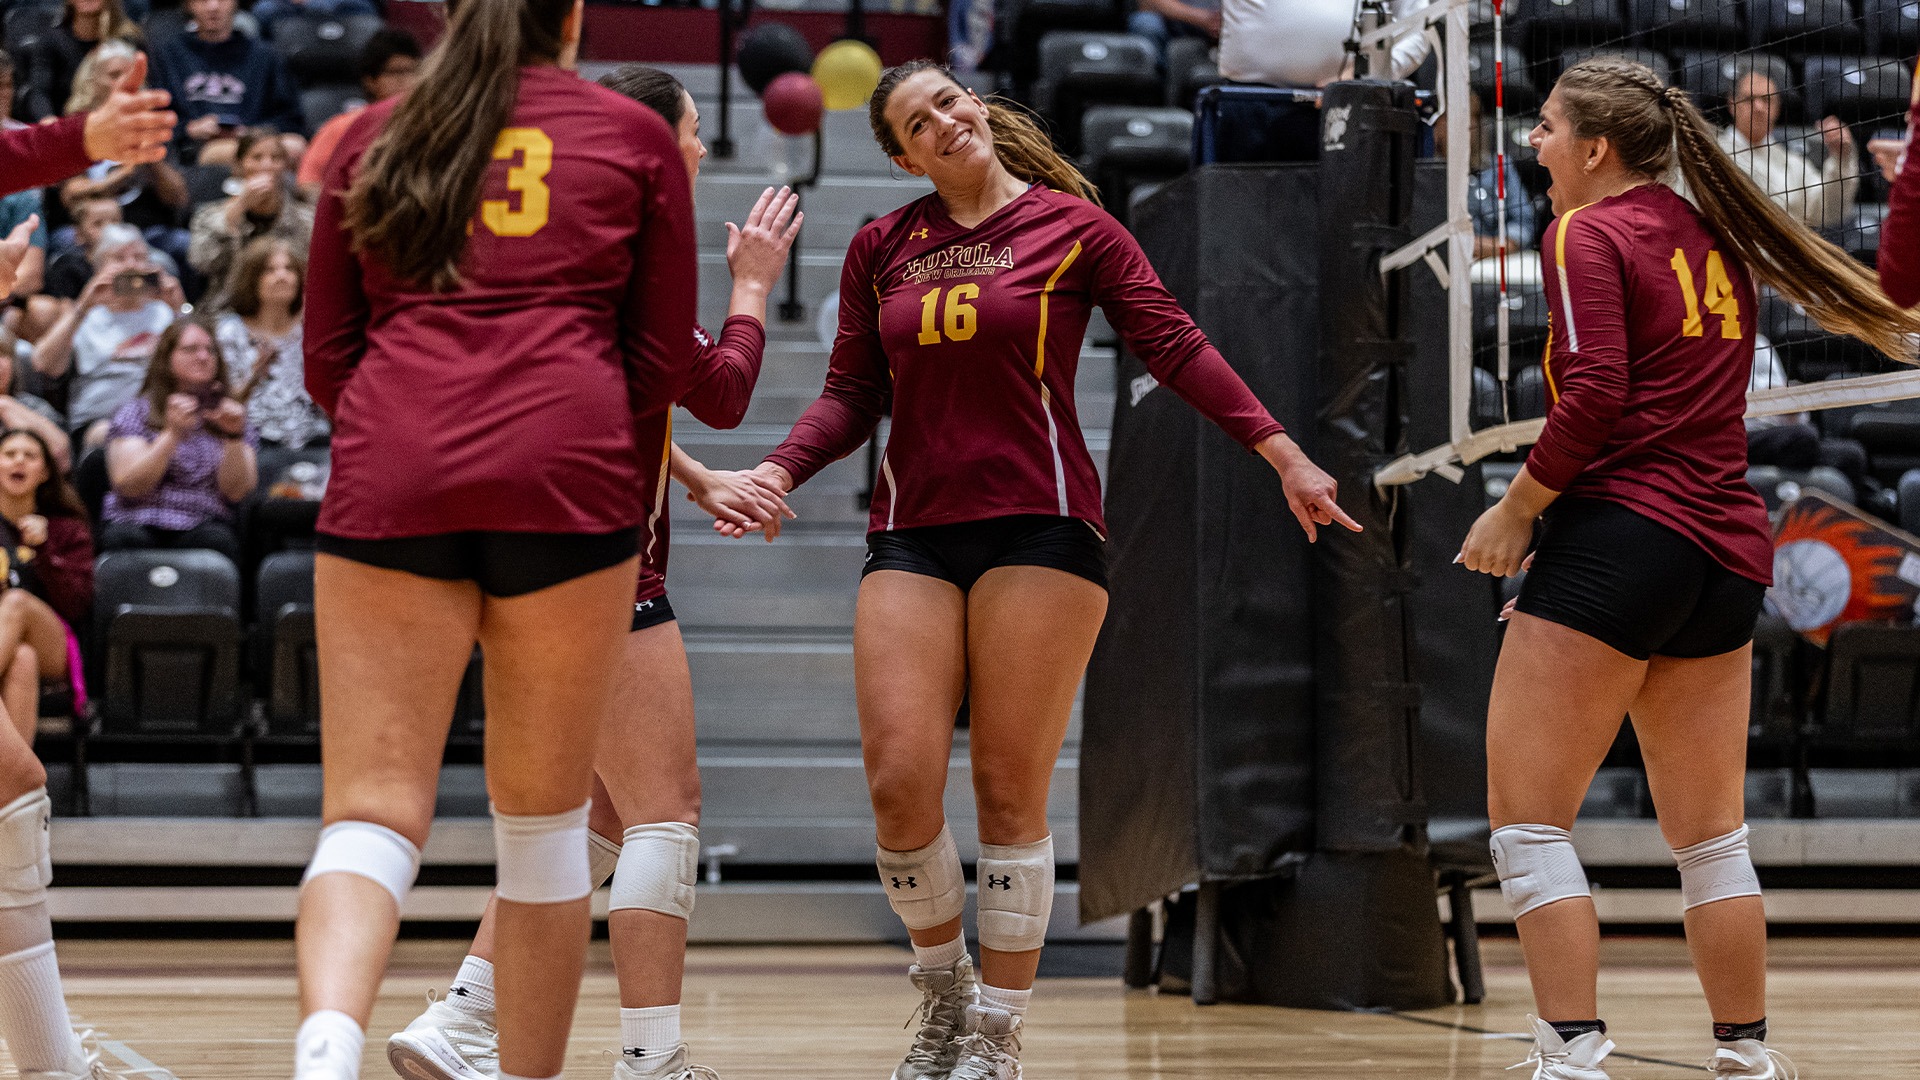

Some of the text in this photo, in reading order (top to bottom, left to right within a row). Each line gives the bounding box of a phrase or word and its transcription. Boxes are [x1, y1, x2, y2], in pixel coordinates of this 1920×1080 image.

[466, 127, 553, 237] 3
[902, 242, 1014, 281] LOYOLA
[914, 266, 996, 285] NEW ORLEANS
[1669, 247, 1743, 340] 14
[917, 282, 980, 346] 16
